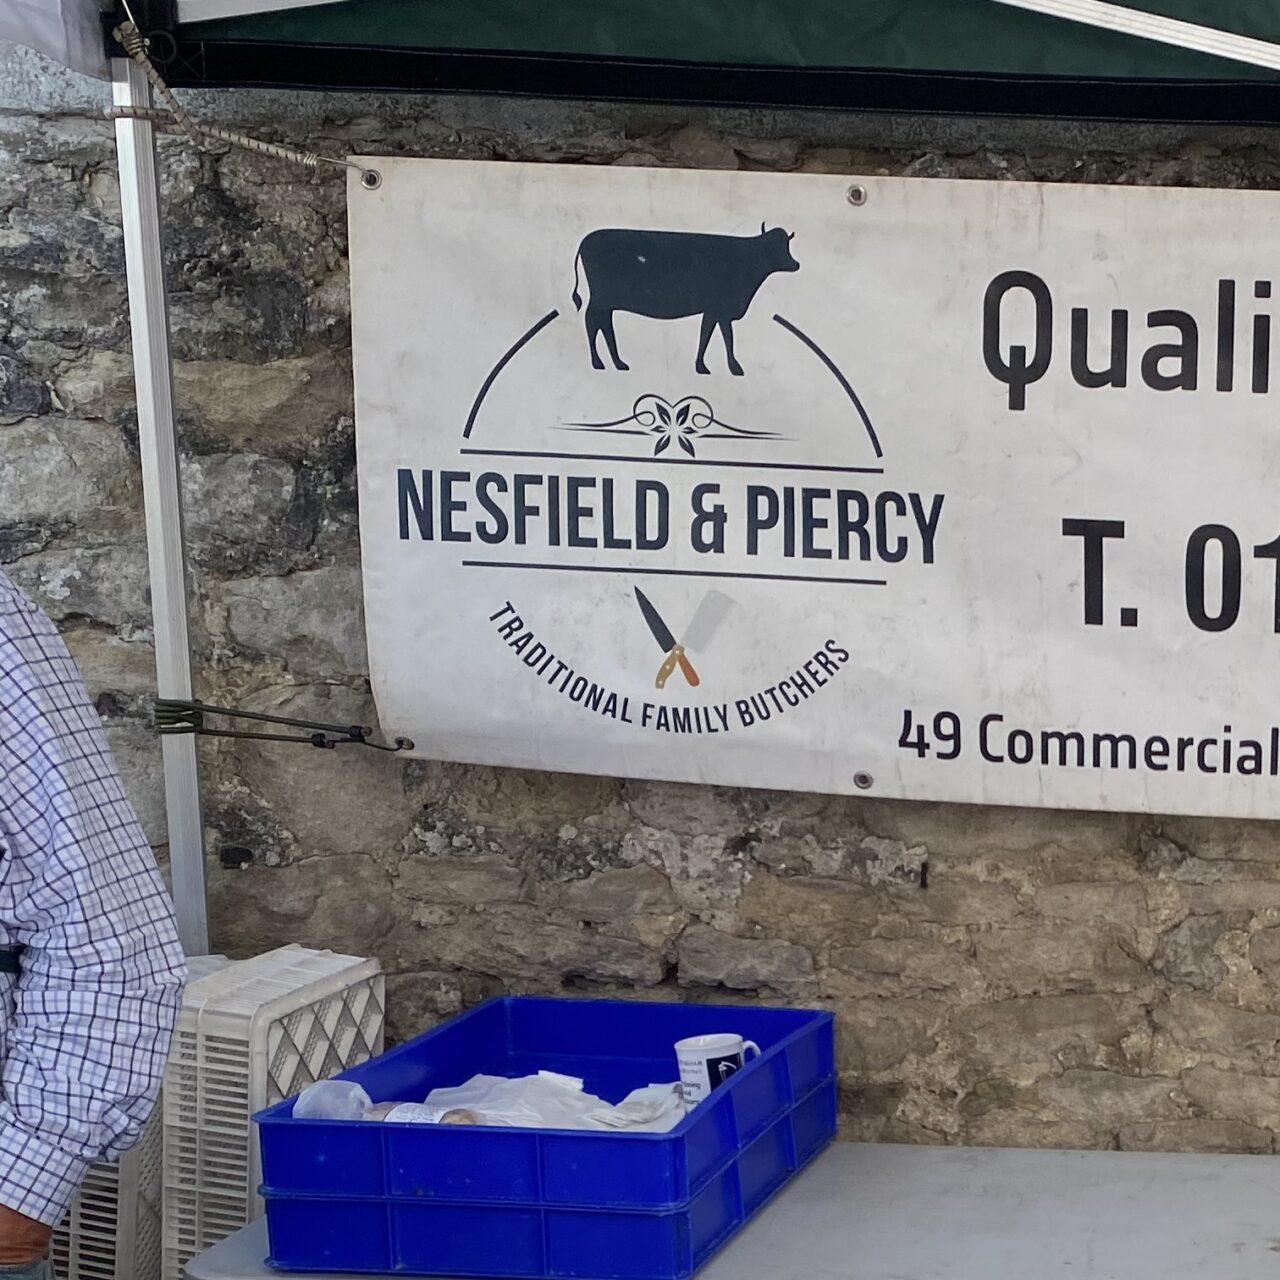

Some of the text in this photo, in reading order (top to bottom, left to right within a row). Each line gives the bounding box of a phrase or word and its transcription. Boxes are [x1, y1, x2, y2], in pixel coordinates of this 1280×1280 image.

[397, 468, 945, 565] NESFIELD & PIERCY
[1062, 517, 1139, 628] T.
[489, 600, 851, 734] TRADITIONAL FAMILY BUTCHERS
[897, 708, 961, 760] 49
[978, 713, 1280, 777] Commercial
